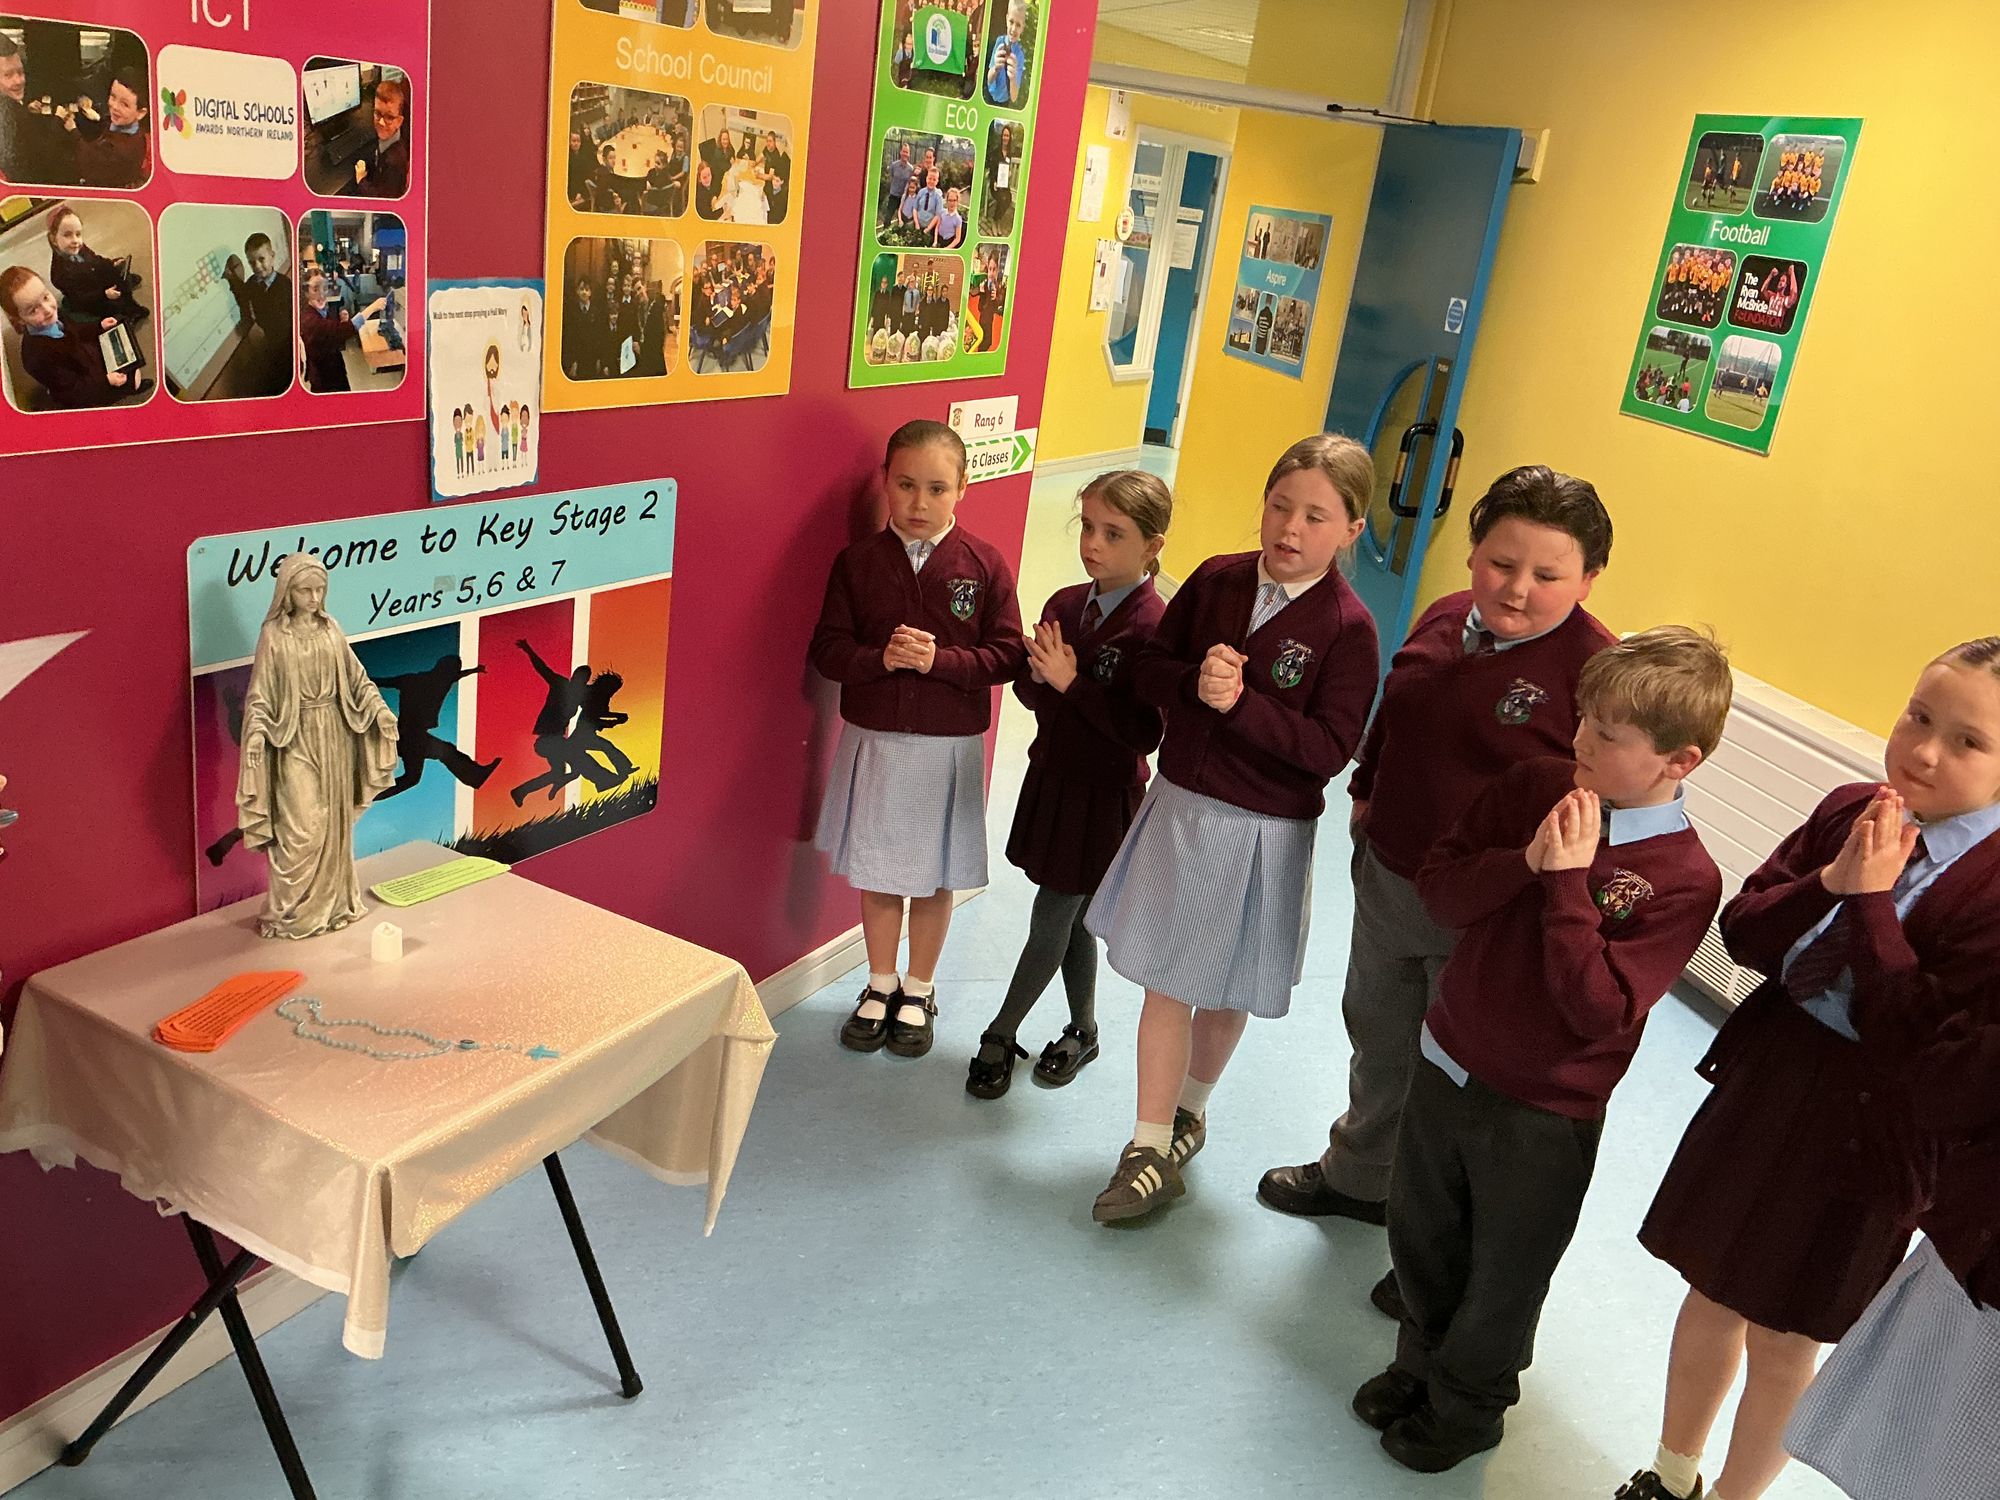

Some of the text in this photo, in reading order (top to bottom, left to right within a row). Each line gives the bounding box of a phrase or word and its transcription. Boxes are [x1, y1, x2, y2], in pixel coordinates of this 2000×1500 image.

[615, 36, 773, 94] School Council
[194, 96, 294, 125] DIGITAL SCHOOLS
[945, 103, 978, 131] ECO
[195, 123, 293, 141] AWARDS NORTHERN IRELAND
[1710, 220, 1771, 246] Football
[1265, 269, 1287, 287] Aspire
[1744, 272, 1759, 286] The
[1740, 285, 1759, 300] Ryan
[1737, 297, 1768, 314] McBride
[974, 410, 1004, 432] Rang 6
[971, 454, 978, 469] 6
[980, 451, 1009, 468] Classes
[420, 524, 457, 554] to
[476, 512, 534, 549] Key
[549, 499, 626, 536] Stage
[639, 490, 659, 520] 2
[368, 559, 567, 625] Years 5,6 & 7
